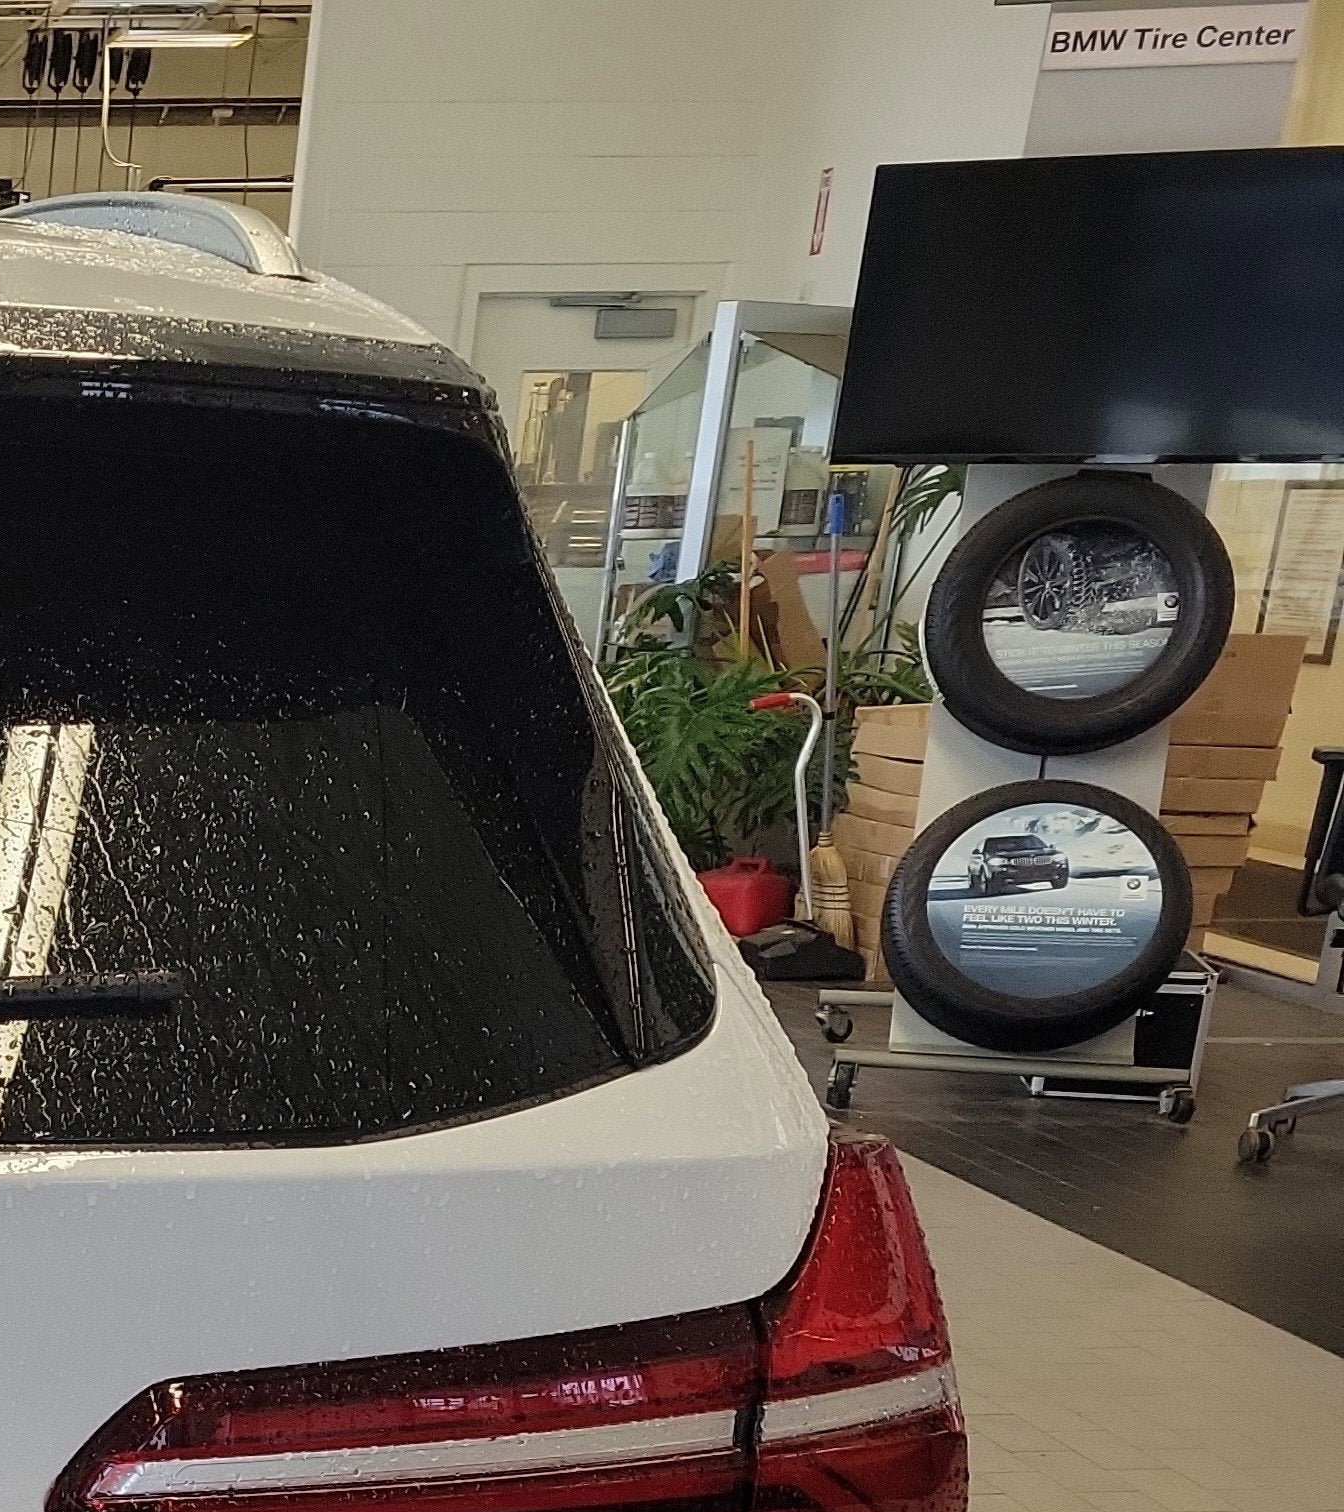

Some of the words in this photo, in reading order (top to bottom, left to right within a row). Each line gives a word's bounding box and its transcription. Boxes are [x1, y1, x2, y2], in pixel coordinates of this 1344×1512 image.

[1050, 28, 1128, 53] BMW
[1134, 27, 1188, 50] Tire
[1196, 25, 1295, 48] Center
[963, 905, 999, 914] EVERY
[1000, 905, 1025, 914] MILE
[1028, 906, 1074, 916] DOESN'T
[1077, 907, 1109, 917] HAVE
[1109, 908, 1125, 917] TO
[962, 913, 989, 922] FEEL
[991, 914, 1016, 923] LIKE
[1017, 915, 1043, 924] TWO
[1046, 916, 1071, 925] THIS
[1072, 917, 1117, 926] WINTER.
